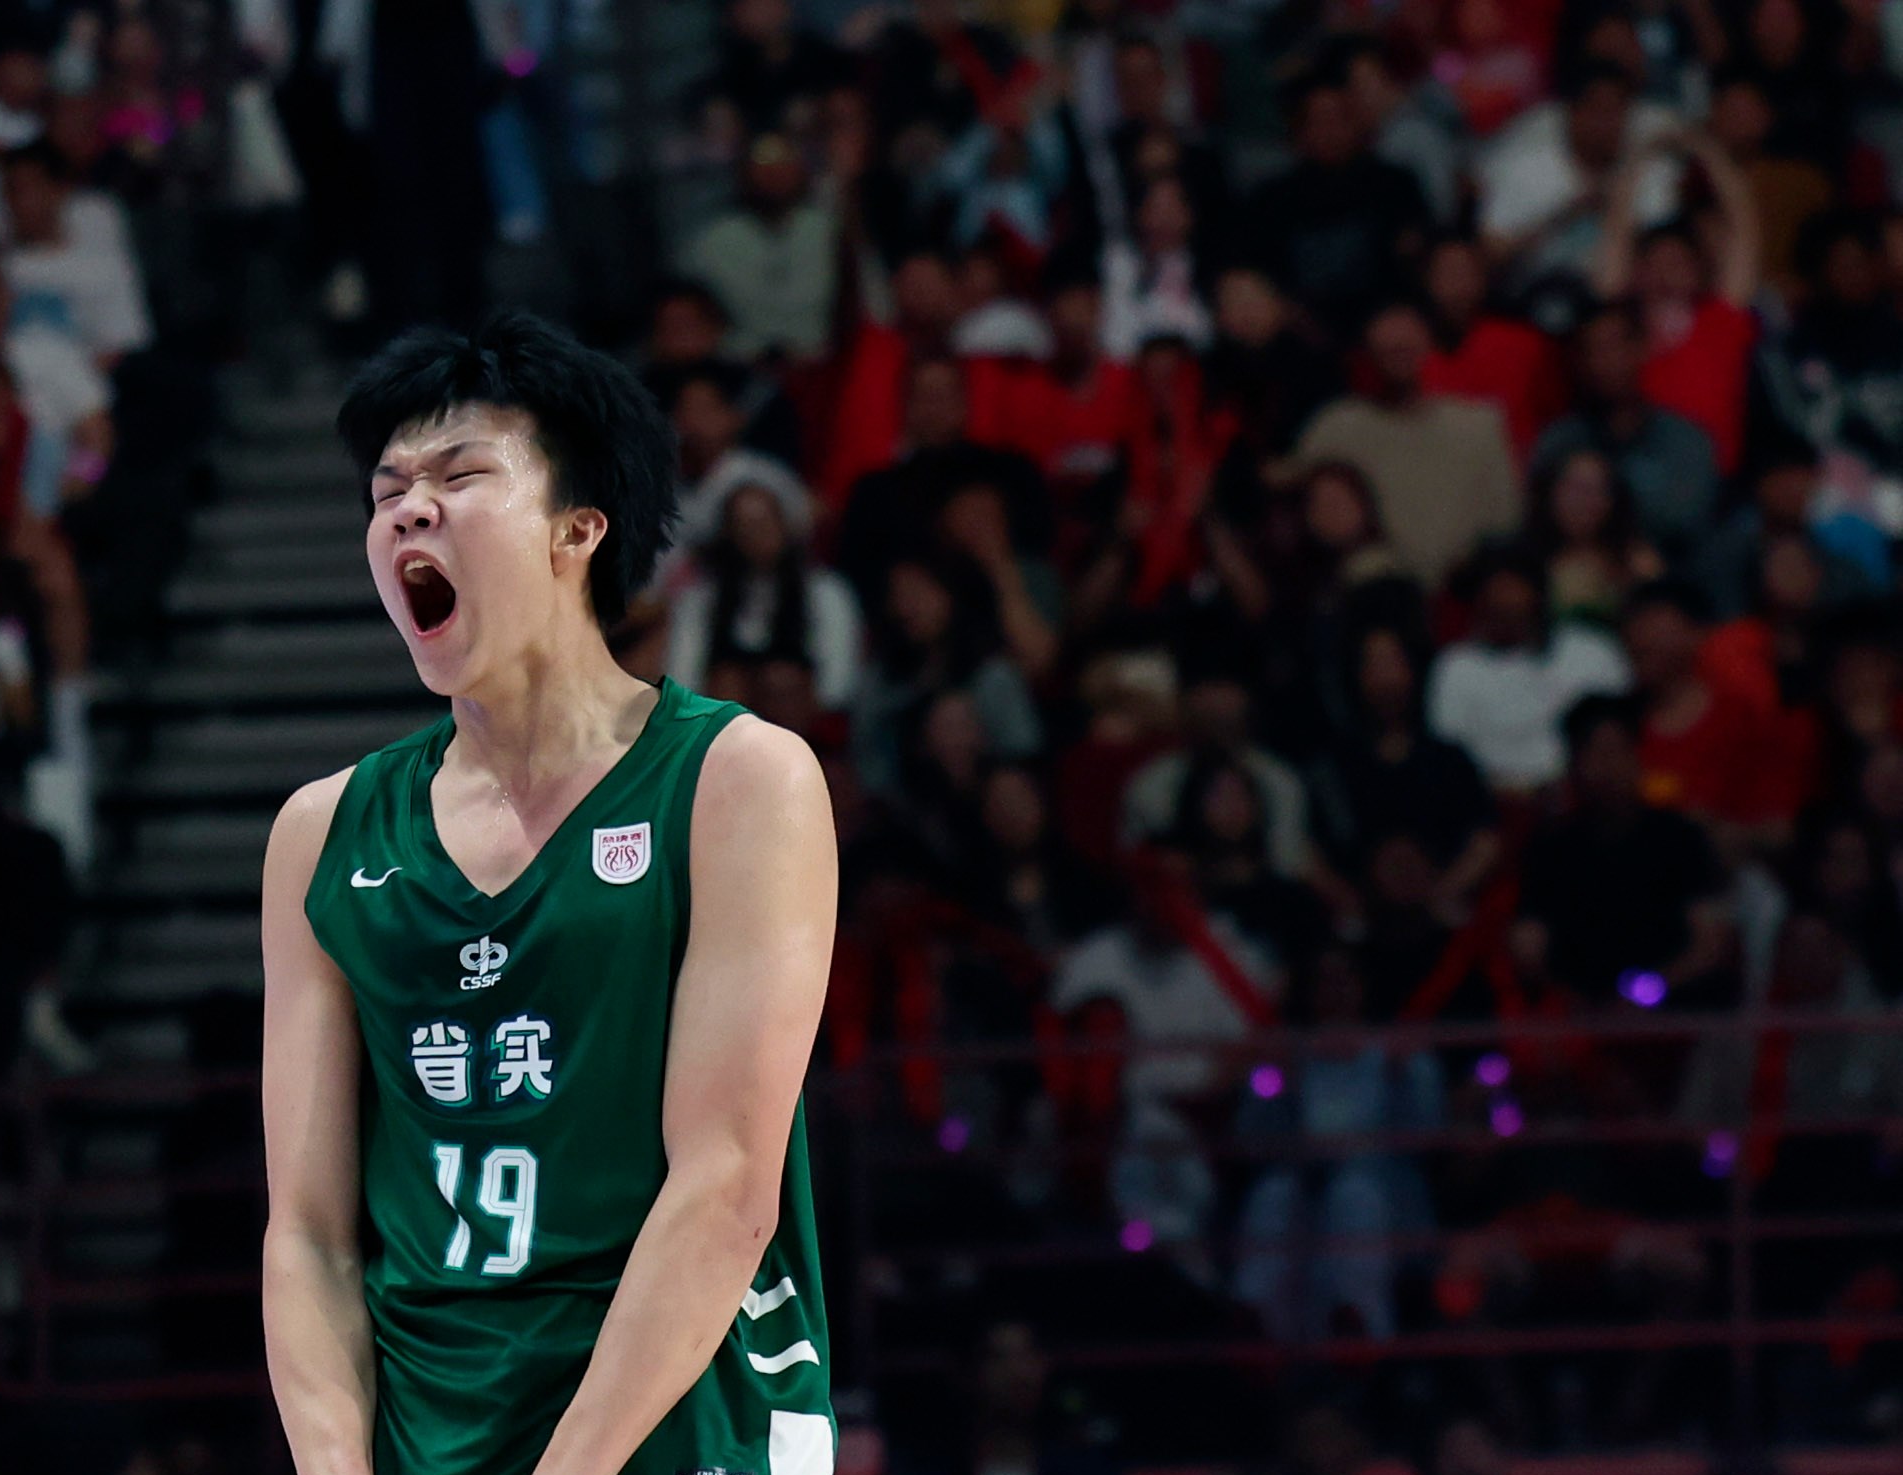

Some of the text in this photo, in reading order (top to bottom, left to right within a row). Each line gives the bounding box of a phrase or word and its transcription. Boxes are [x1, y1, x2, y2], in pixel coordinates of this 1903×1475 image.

[459, 972, 502, 991] CSSF
[411, 1014, 554, 1104] 省实
[432, 1144, 539, 1278] 19
